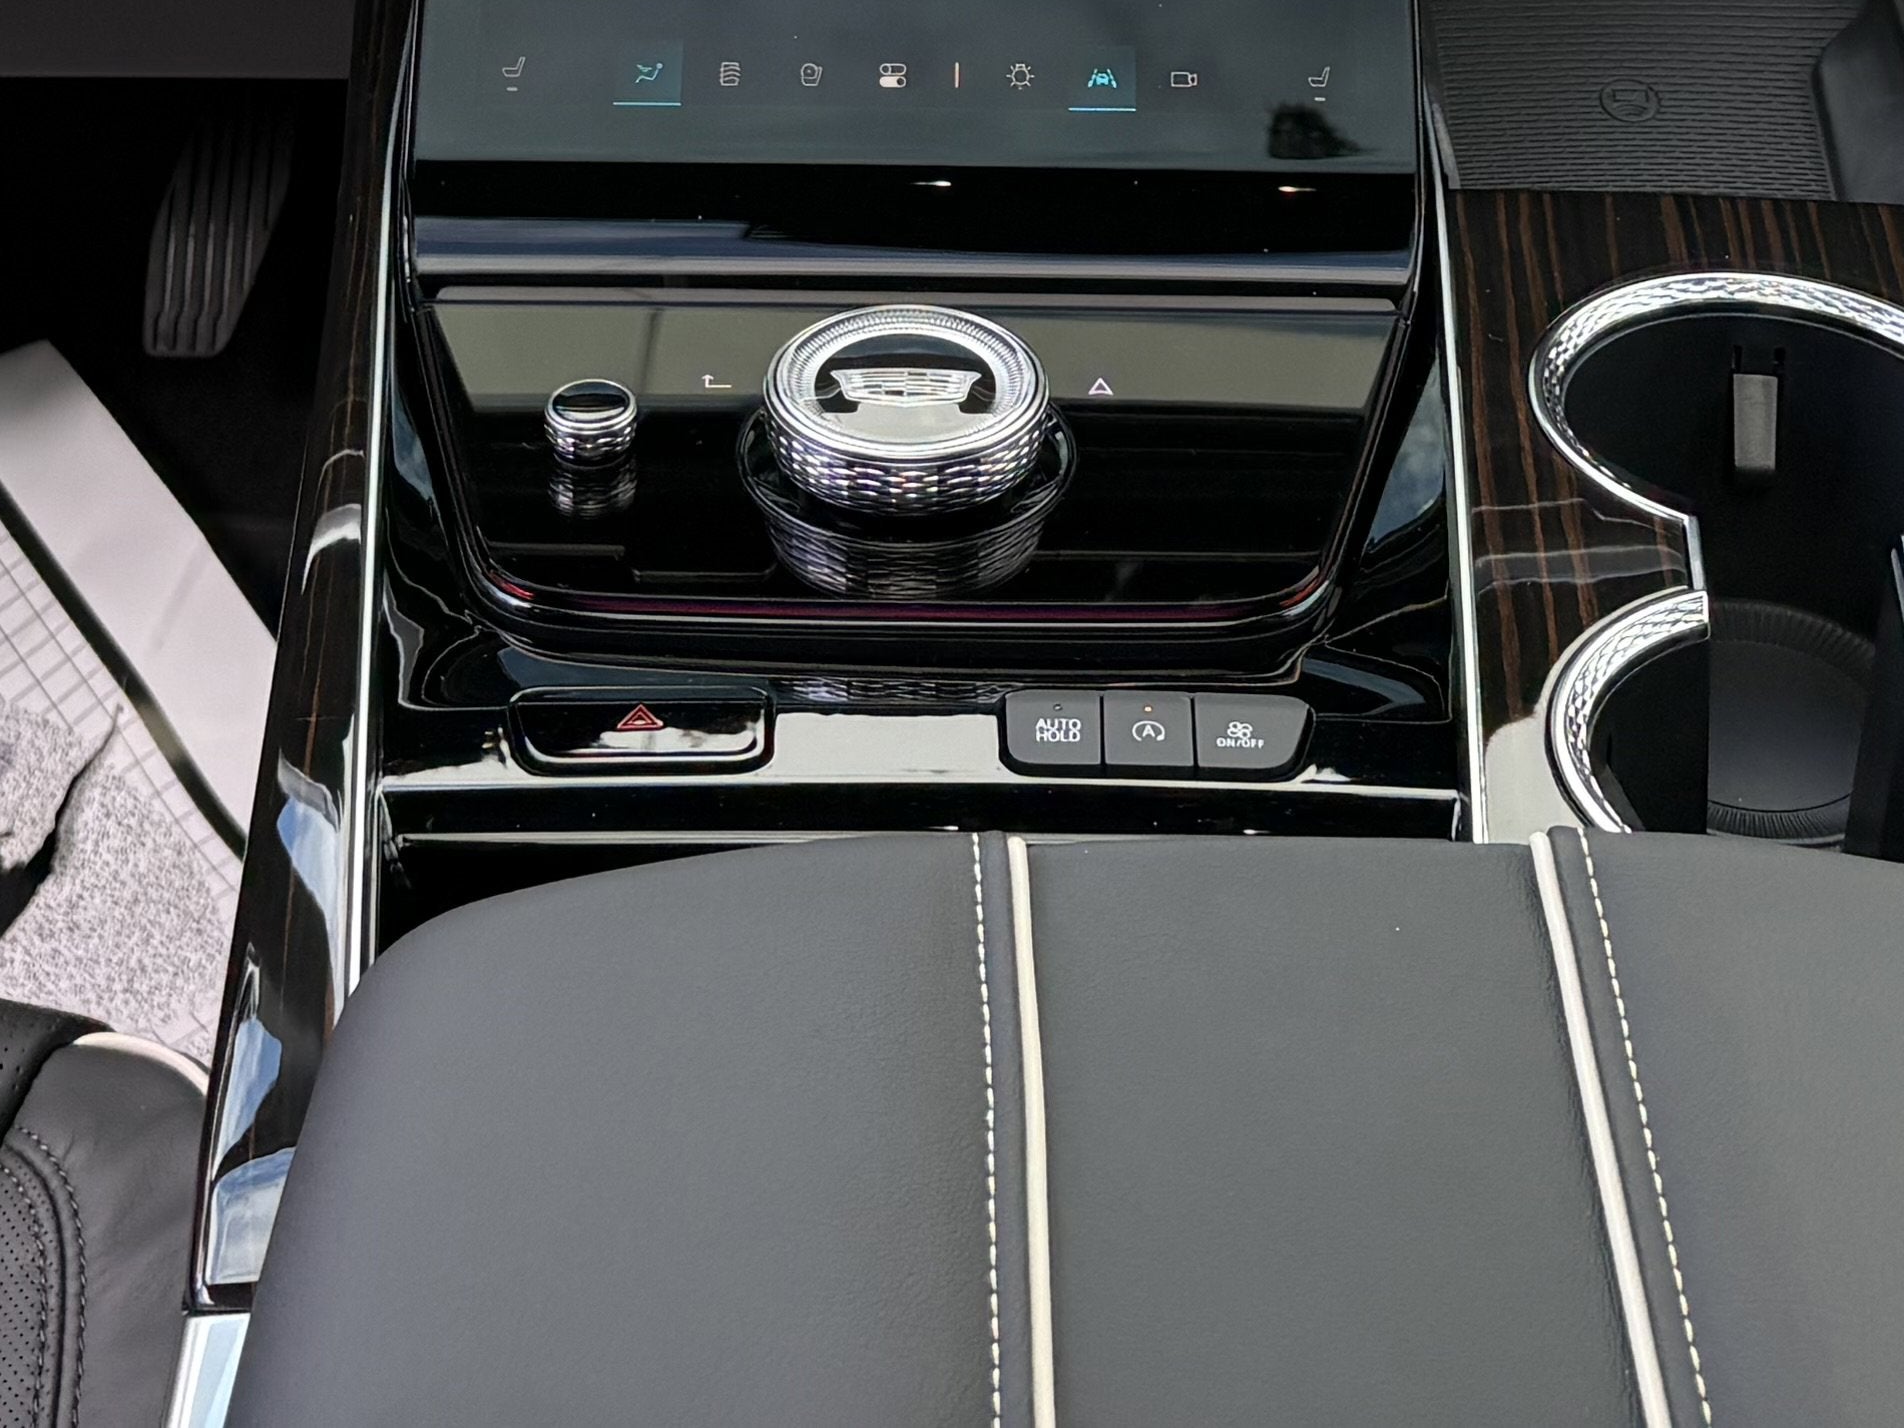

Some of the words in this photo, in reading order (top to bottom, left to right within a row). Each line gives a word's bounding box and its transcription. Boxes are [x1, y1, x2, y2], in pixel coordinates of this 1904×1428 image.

[1035, 718, 1082, 731] AUTO
[1035, 730, 1081, 743] HOLD
[1216, 736, 1265, 749] ON/OFF
